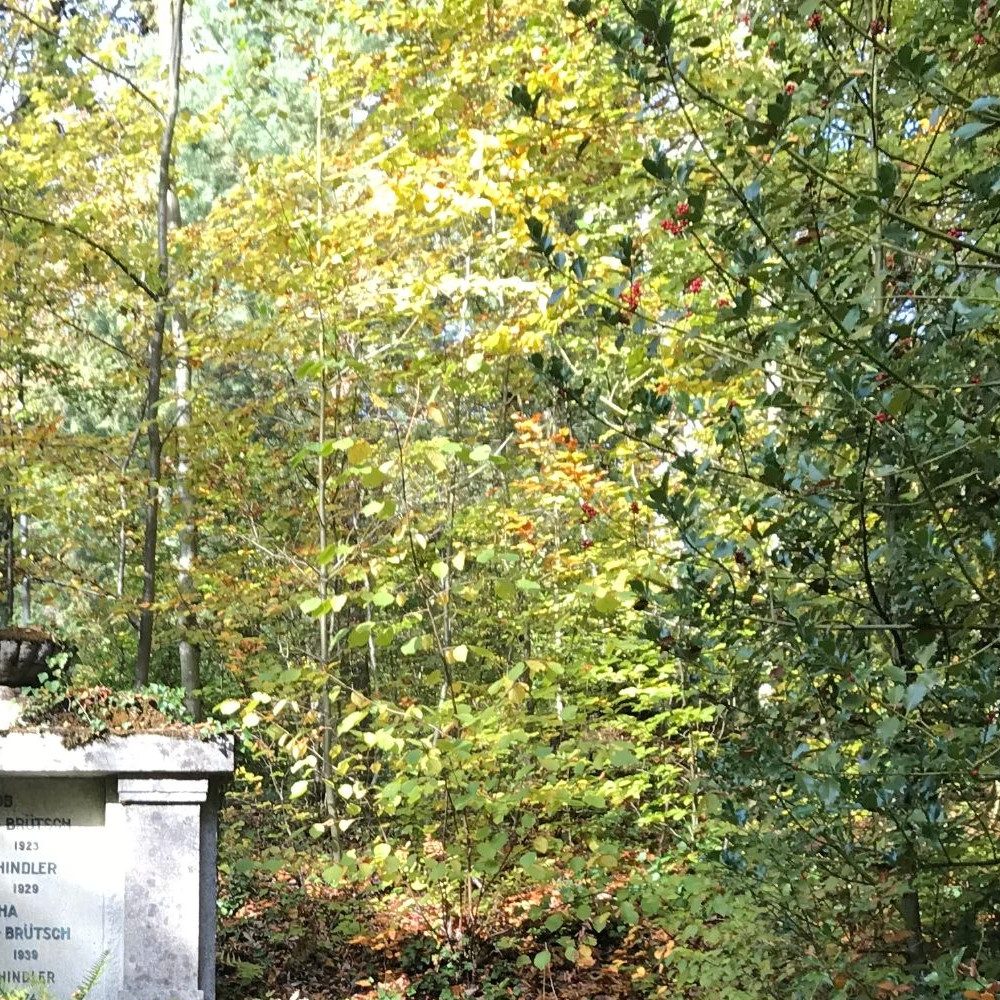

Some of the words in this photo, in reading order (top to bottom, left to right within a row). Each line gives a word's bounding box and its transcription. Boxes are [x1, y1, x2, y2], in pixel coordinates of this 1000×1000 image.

[5, 814, 71, 830] BRÜTSCH
[13, 883, 39, 894] 1929
[5, 923, 71, 940] BRÜTSCH
